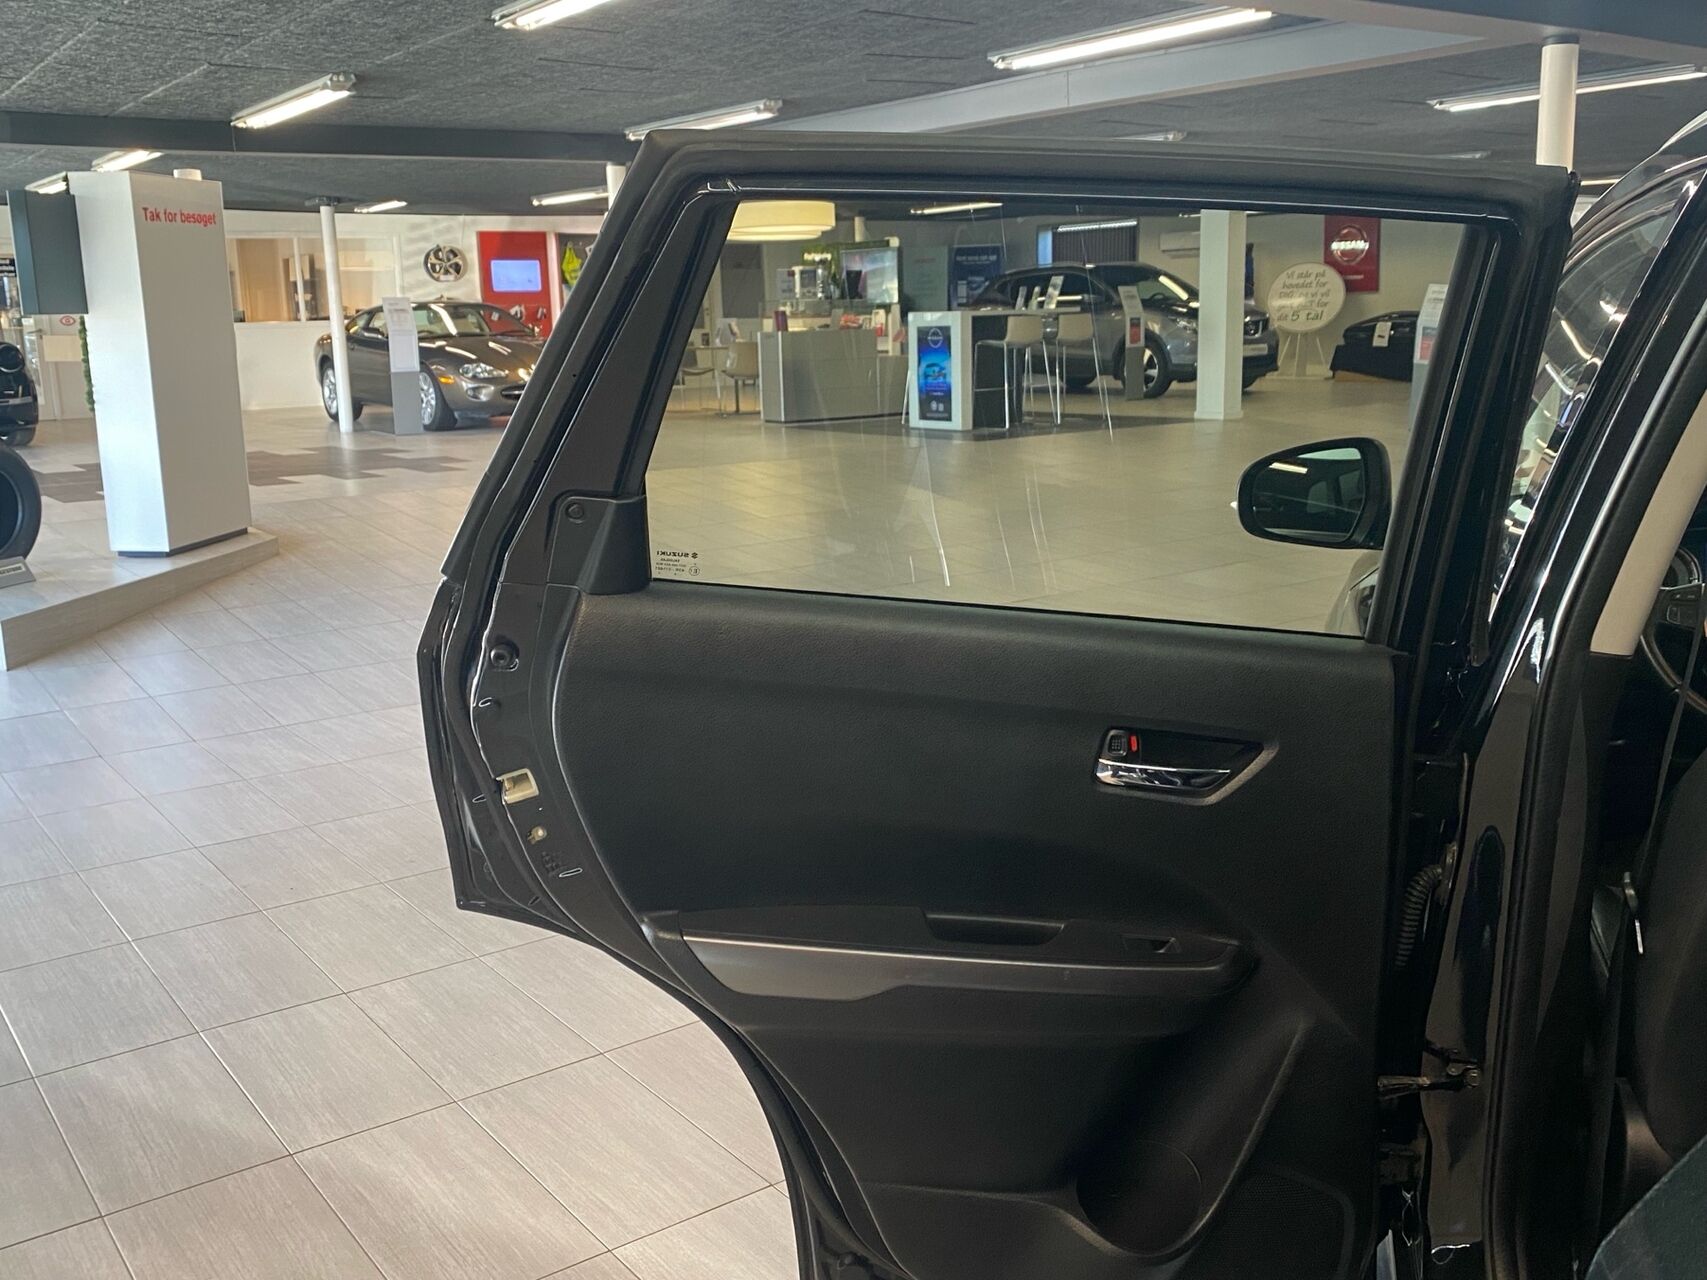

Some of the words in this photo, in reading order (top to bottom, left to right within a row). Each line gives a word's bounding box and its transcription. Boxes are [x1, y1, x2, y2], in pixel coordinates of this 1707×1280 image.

[142, 207, 161, 222] Tak
[164, 209, 177, 222] for
[180, 209, 216, 227] besøget
[1291, 311, 1299, 321] 5
